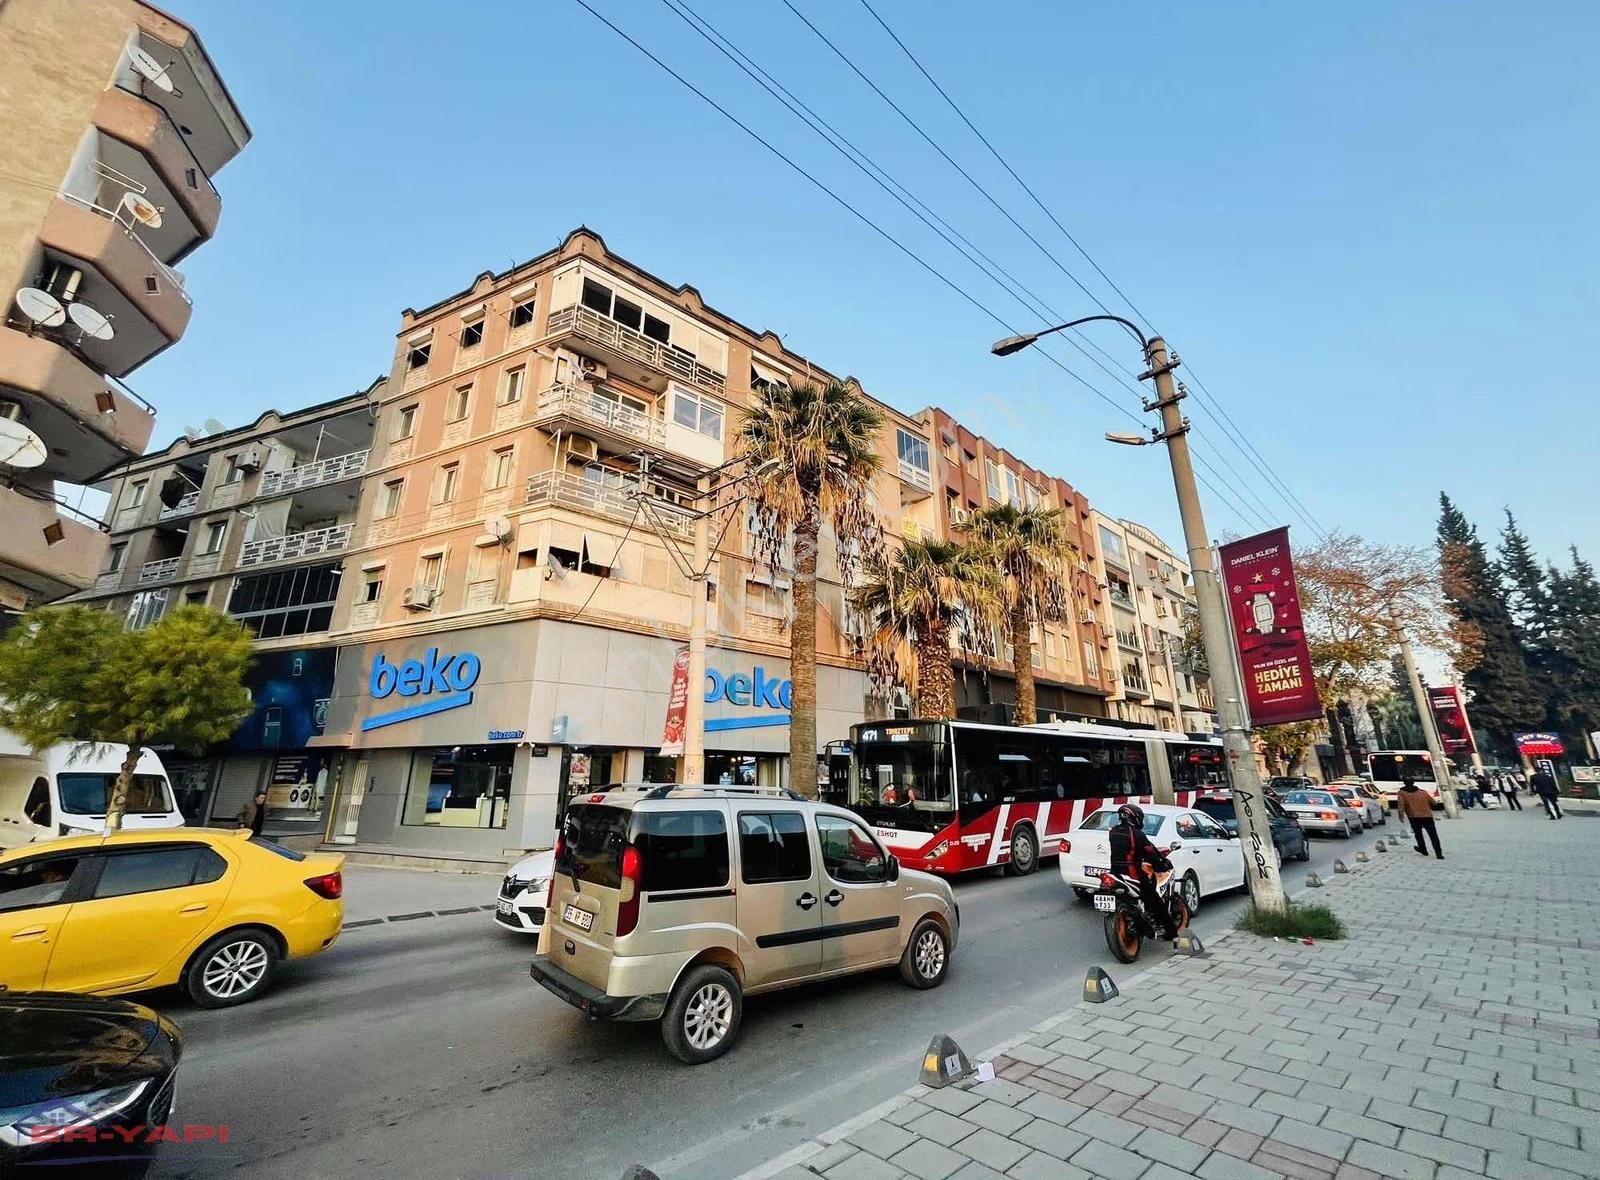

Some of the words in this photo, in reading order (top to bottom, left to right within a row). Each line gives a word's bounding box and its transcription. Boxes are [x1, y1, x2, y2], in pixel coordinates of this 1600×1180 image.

[1231, 554, 1256, 565] DANIEL
[1256, 547, 1278, 558] KLEIN
[369, 647, 482, 700] beko
[1254, 665, 1301, 683] HEDİYE
[1256, 677, 1303, 694] ZAMANI
[862, 729, 878, 741] 471
[876, 829, 898, 839] ESHOT
